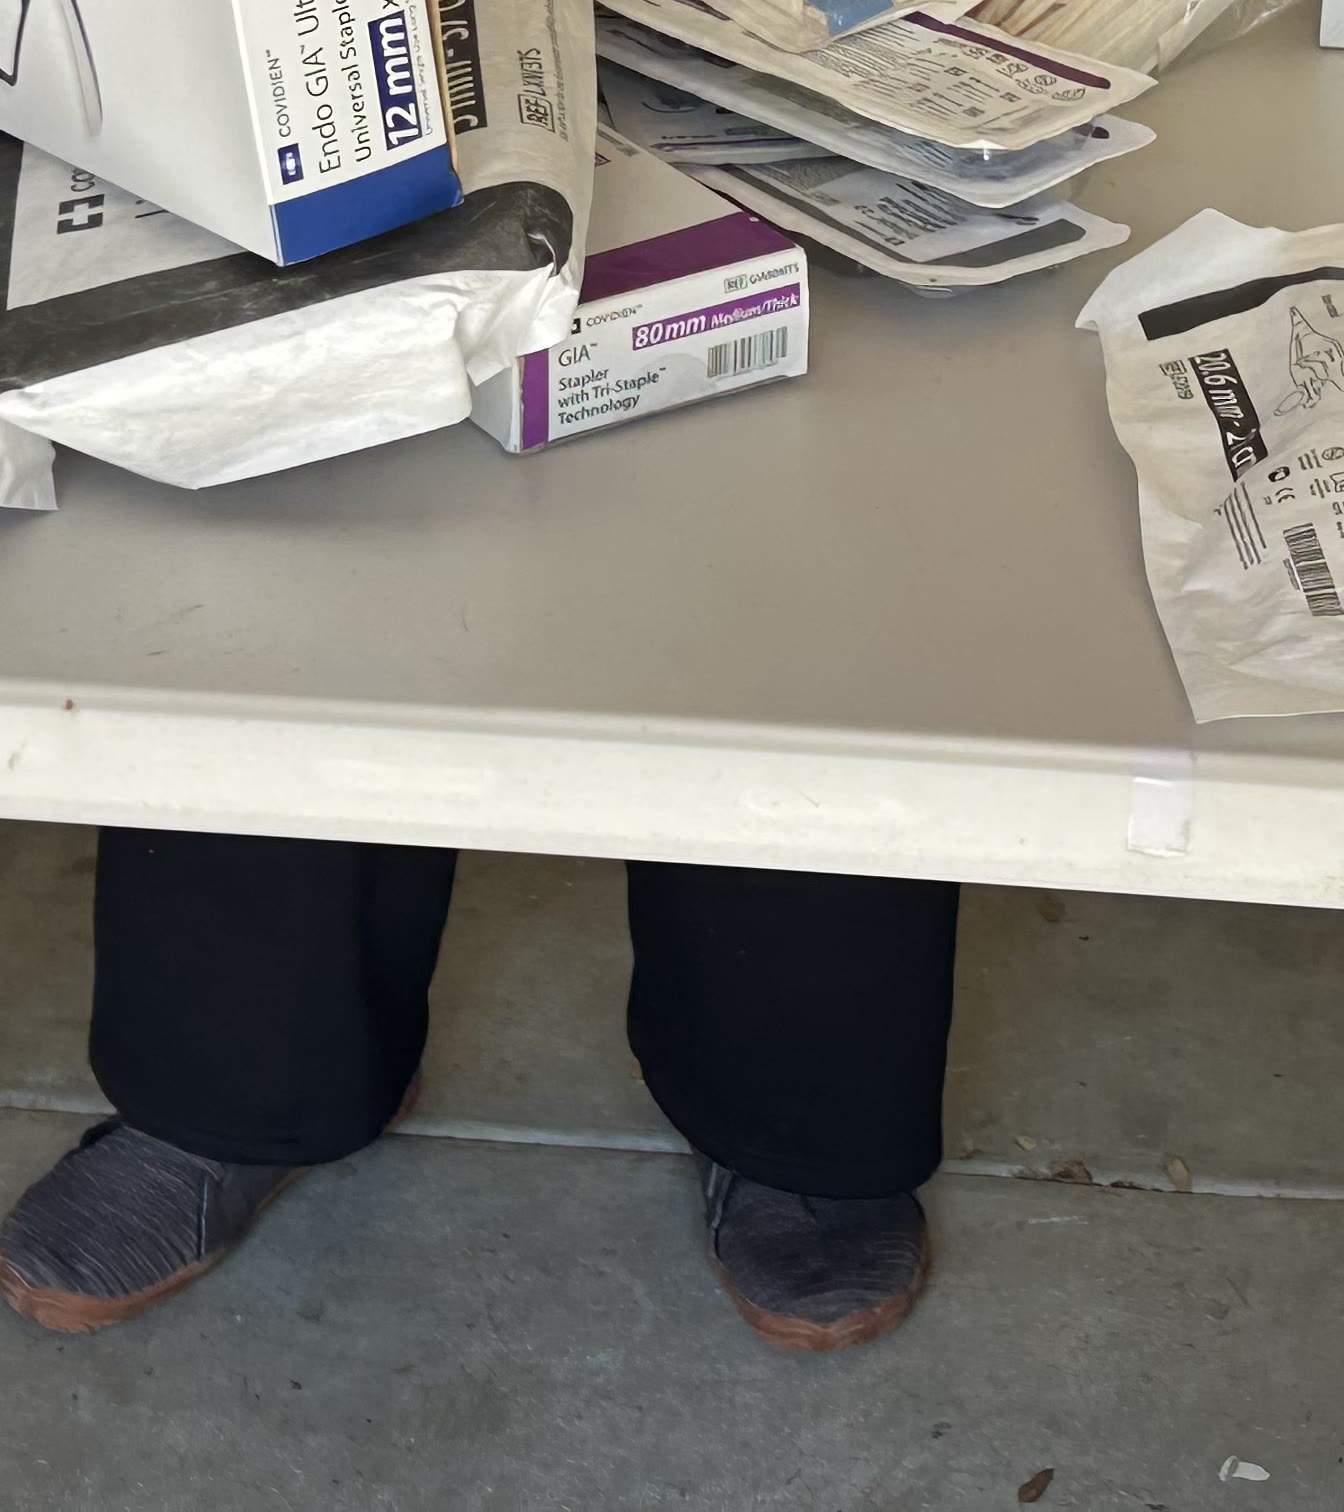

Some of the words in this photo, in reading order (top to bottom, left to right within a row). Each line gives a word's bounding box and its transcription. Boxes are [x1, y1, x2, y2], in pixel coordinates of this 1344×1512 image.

[379, 17, 413, 96] mm
[341, 64, 372, 163] Universal
[385, 102, 420, 145] 12
[312, 104, 342, 174] Endo
[635, 314, 707, 349] 80mm
[558, 368, 609, 392] Stapler
[1193, 352, 1238, 388] 20.6
[558, 389, 590, 410] with
[558, 393, 641, 426] Technology
